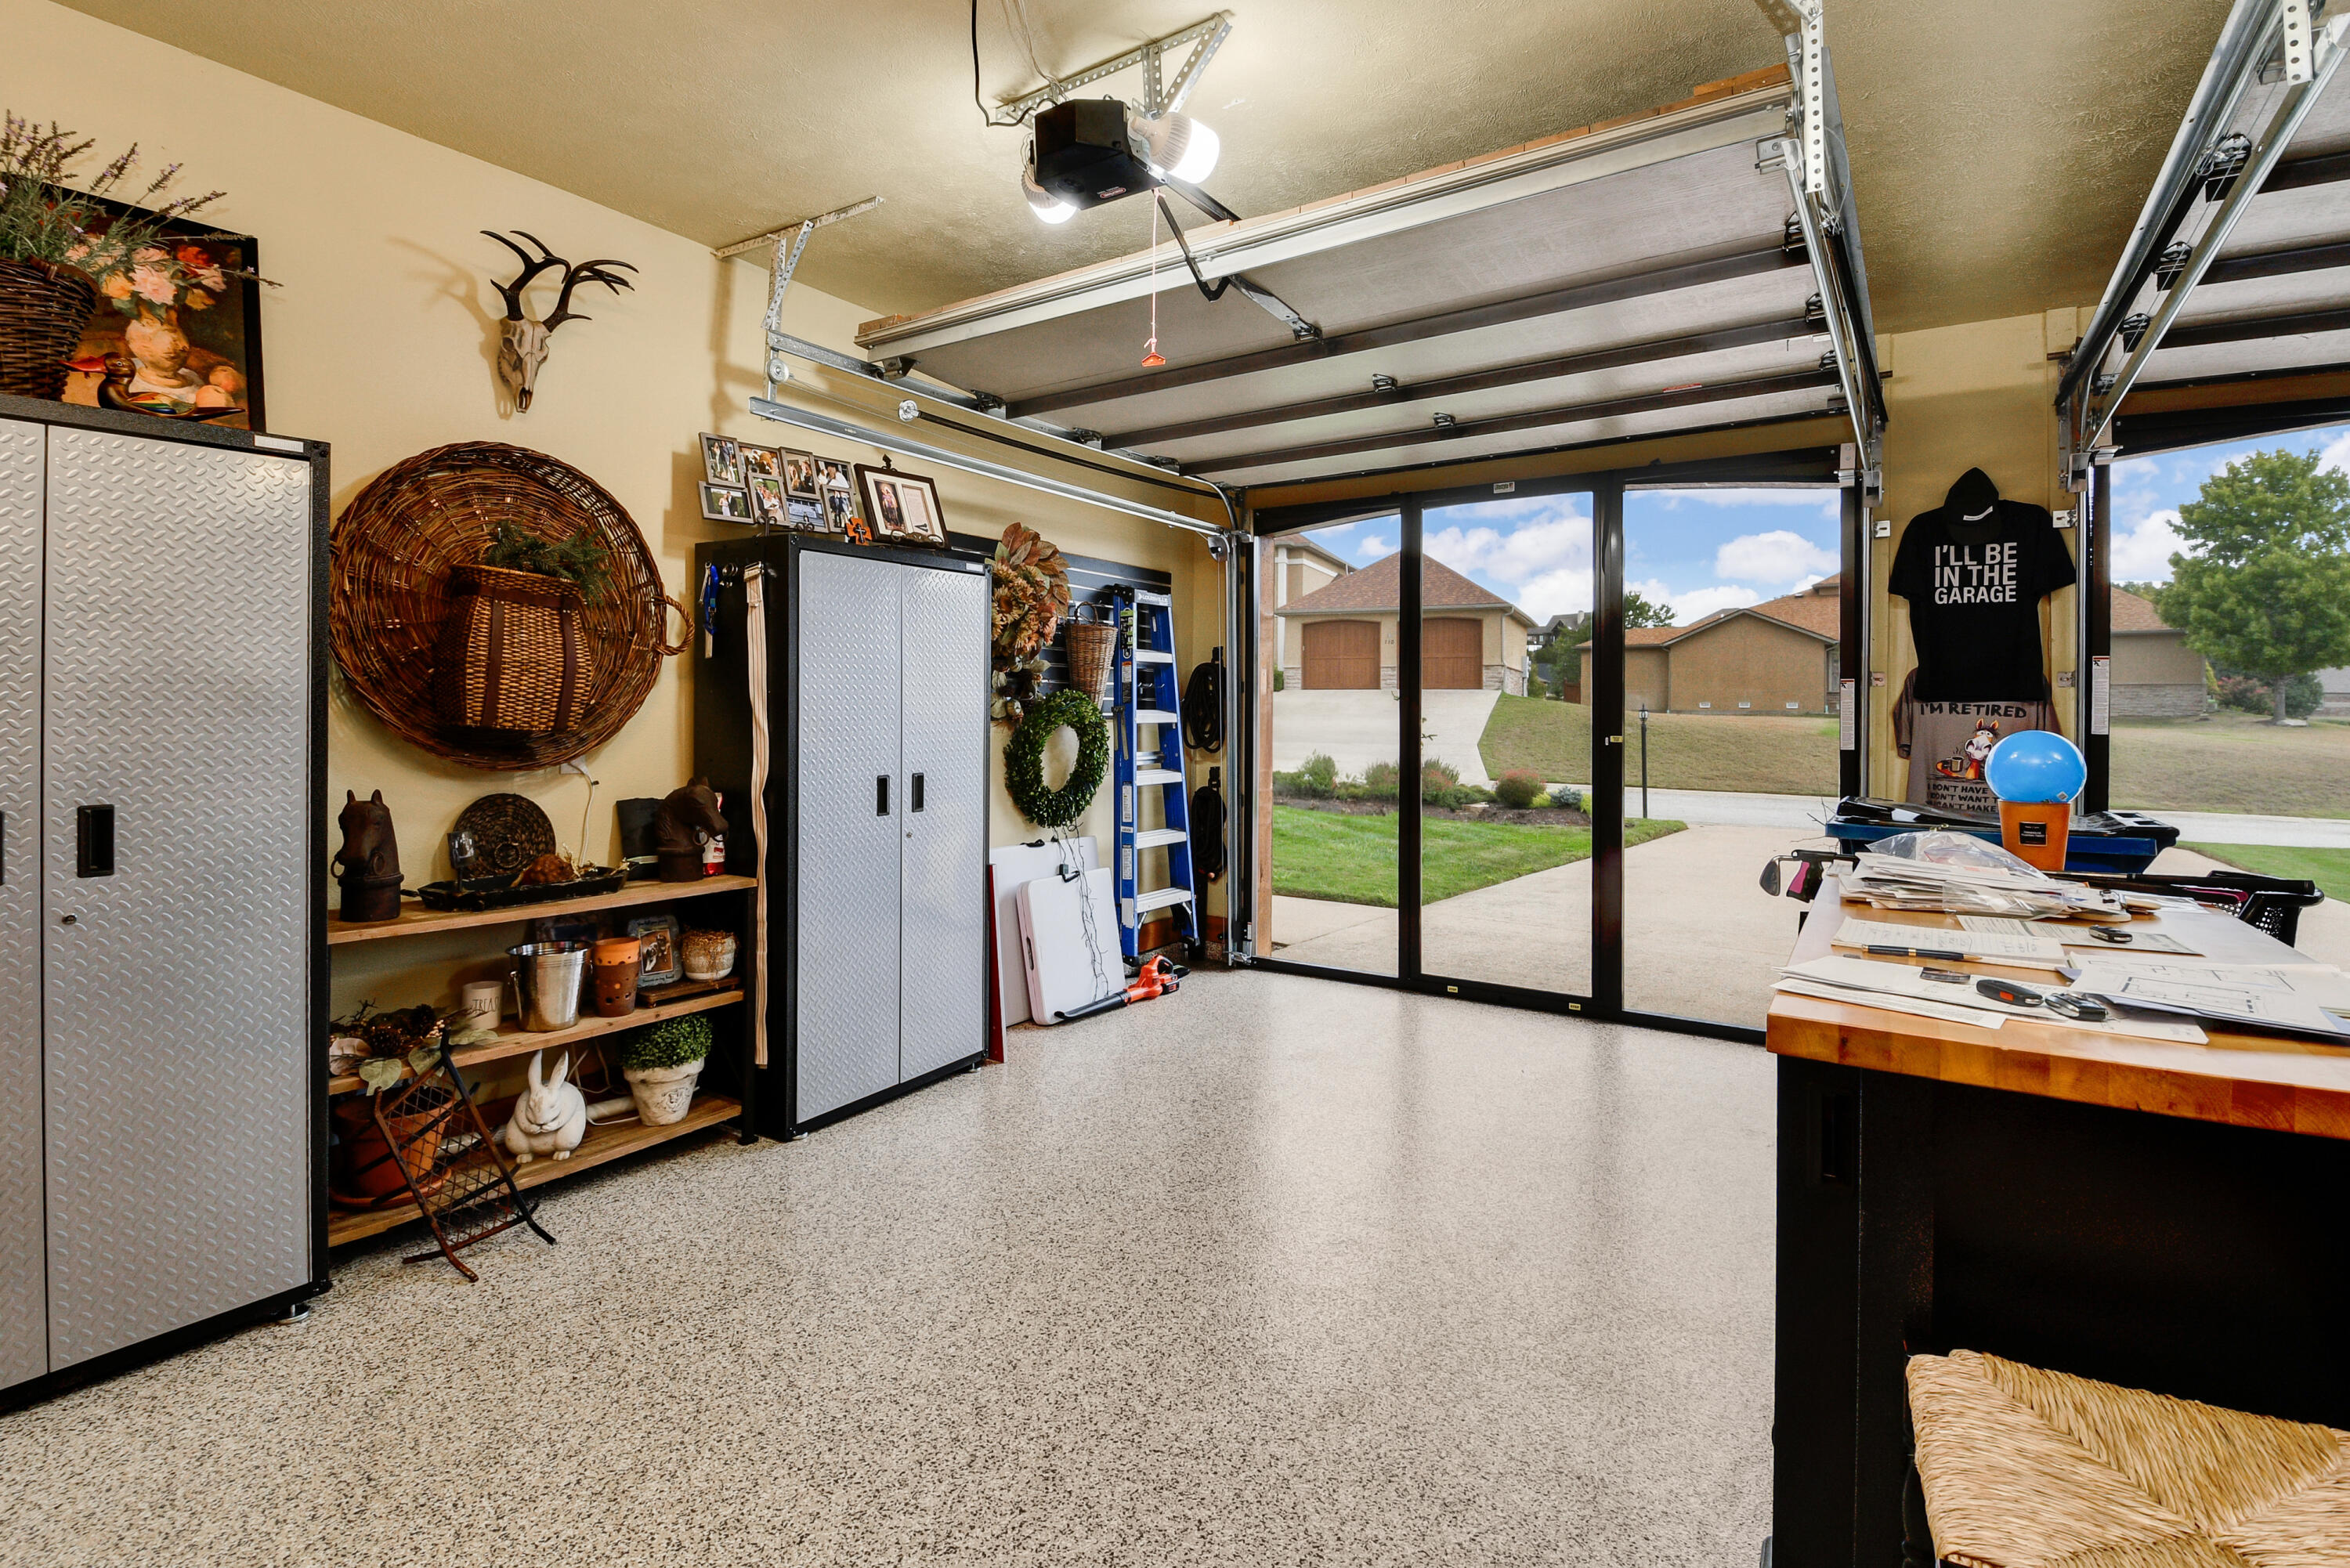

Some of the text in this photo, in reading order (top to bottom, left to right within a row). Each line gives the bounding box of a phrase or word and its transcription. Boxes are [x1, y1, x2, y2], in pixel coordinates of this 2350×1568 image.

[1935, 542, 2017, 565] I'LL BE
[1935, 563, 2016, 587] IN THE
[1934, 585, 2016, 604] GARAGE
[1920, 702, 2026, 717] I'M RETIRED
[1932, 784, 1958, 793] DON'T
[1961, 786, 1989, 794] HAVE
[1958, 794, 1989, 804] WANT
[1967, 804, 1997, 813] MAKE
